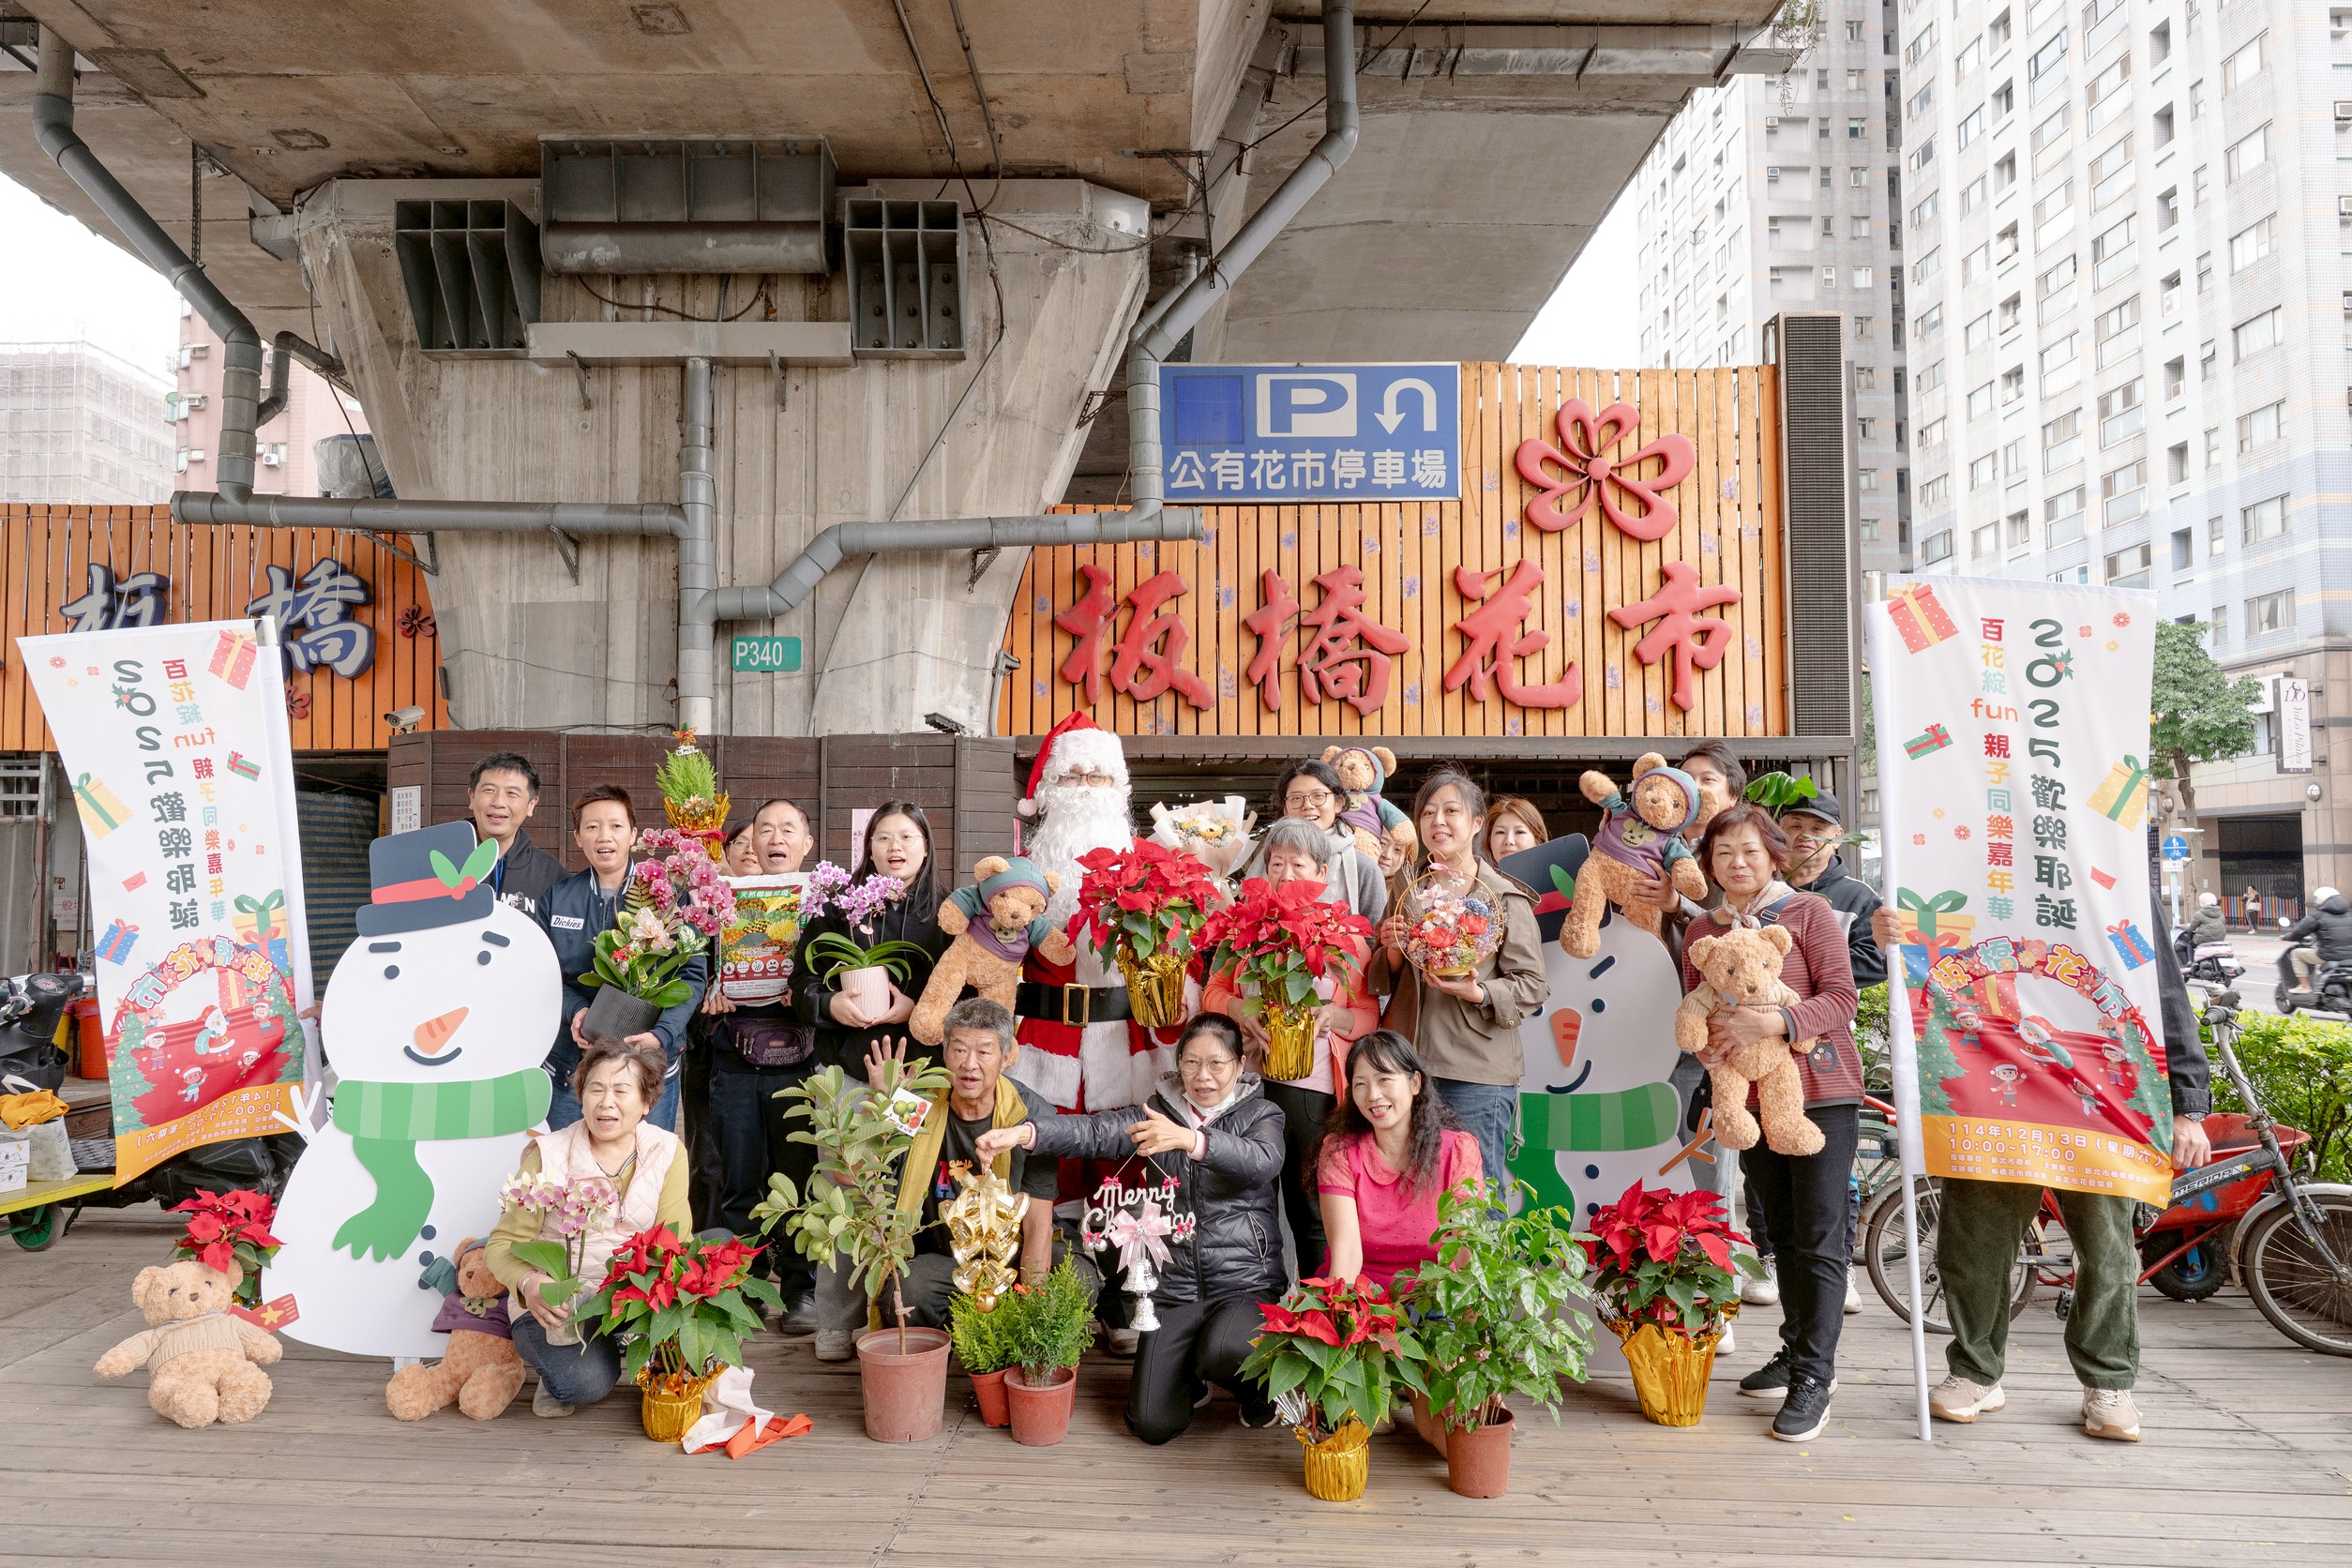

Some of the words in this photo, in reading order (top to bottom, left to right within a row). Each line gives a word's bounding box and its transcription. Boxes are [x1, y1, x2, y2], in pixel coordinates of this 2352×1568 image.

[1268, 378, 1348, 434] P
[1168, 449, 1446, 490] 公有花市停車場
[735, 641, 783, 666] P340
[1055, 559, 1741, 716] 板橋花市
[1930, 937, 2132, 1020] 板橋花市
[1949, 1138, 2075, 1162] 10:00~17:00
[1093, 1183, 1176, 1212] Merry
